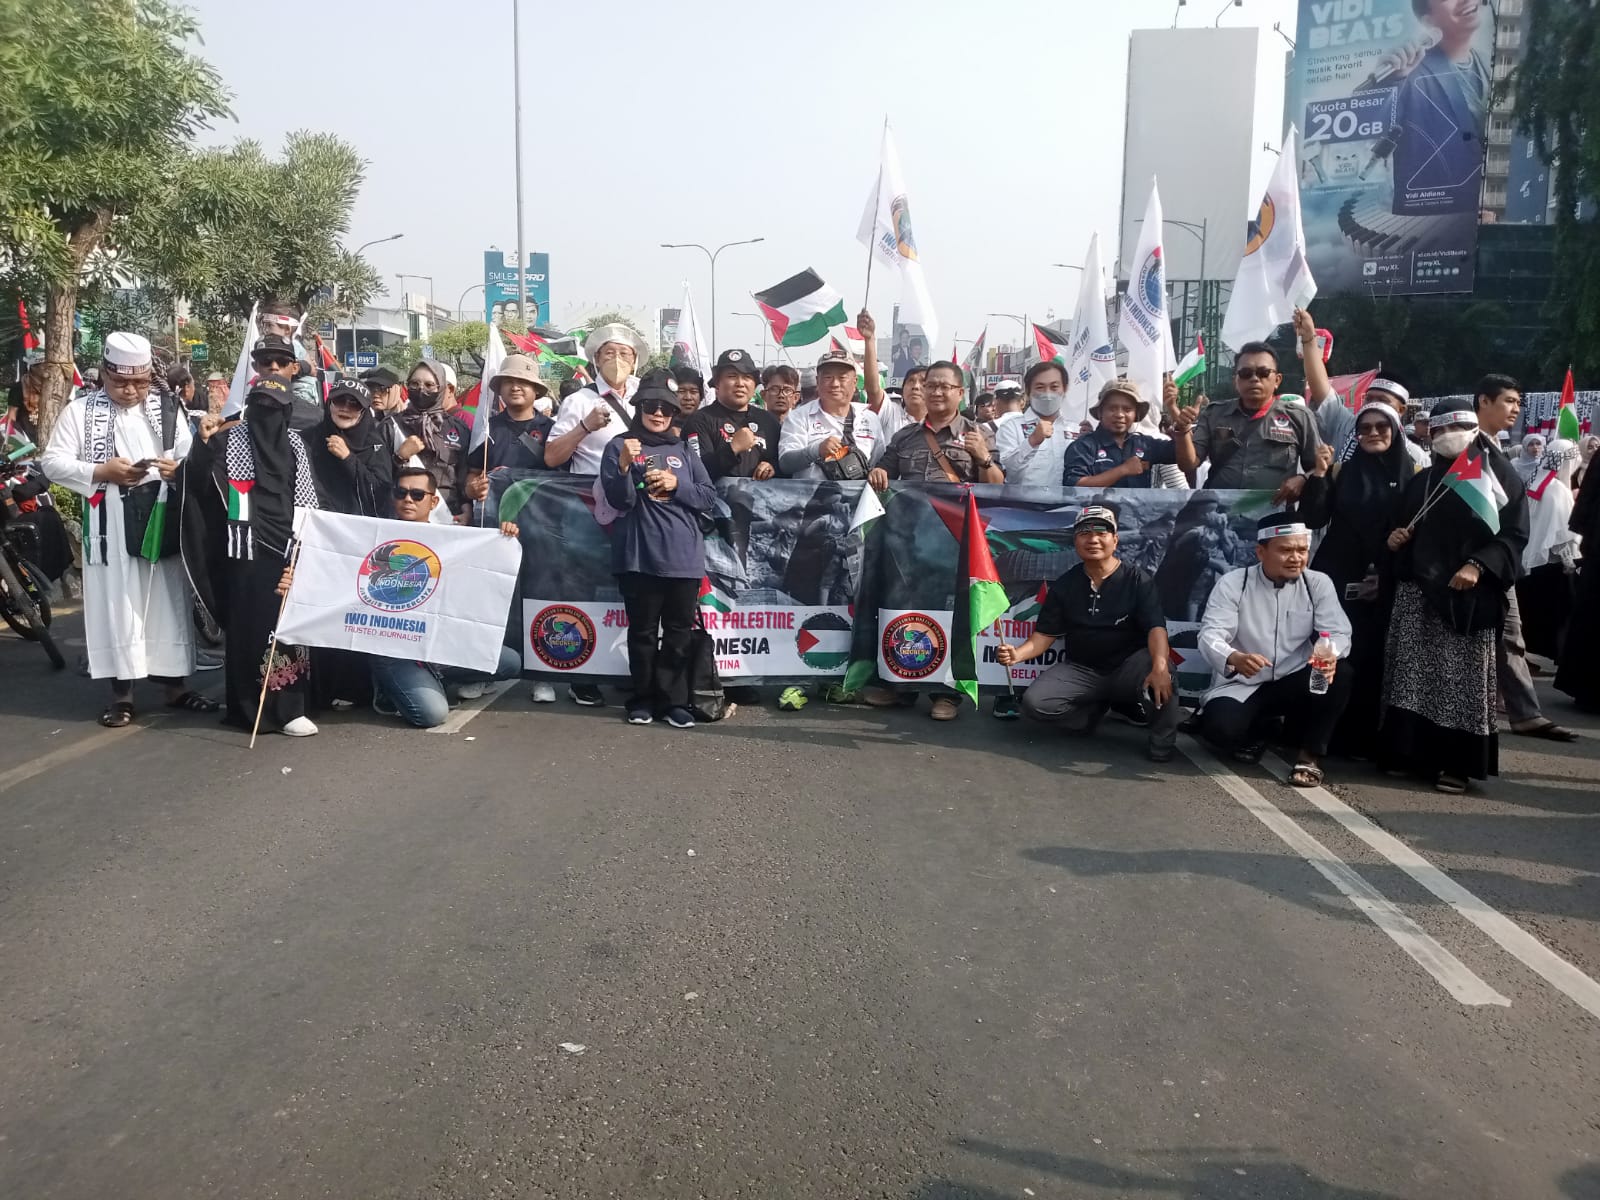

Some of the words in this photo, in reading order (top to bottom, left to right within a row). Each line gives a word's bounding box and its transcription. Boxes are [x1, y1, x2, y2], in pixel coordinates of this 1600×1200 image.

[1311, 0, 1372, 24] VIDI
[1309, 13, 1403, 49] BEATS
[1307, 65, 1331, 74] musik
[1335, 60, 1362, 70] favorit
[1312, 101, 1347, 113] Kuota
[1350, 97, 1384, 109] Besar
[1129, 302, 1161, 343] INDONESIA
[344, 612, 368, 625] IWO
[369, 614, 426, 634] INDONESIA
[722, 610, 795, 629] PALESTINE
[344, 625, 378, 636] TRUSTED
[379, 630, 422, 642] JOURNALIST
[713, 637, 770, 656] NESIA
[1011, 669, 1037, 679] BELA
